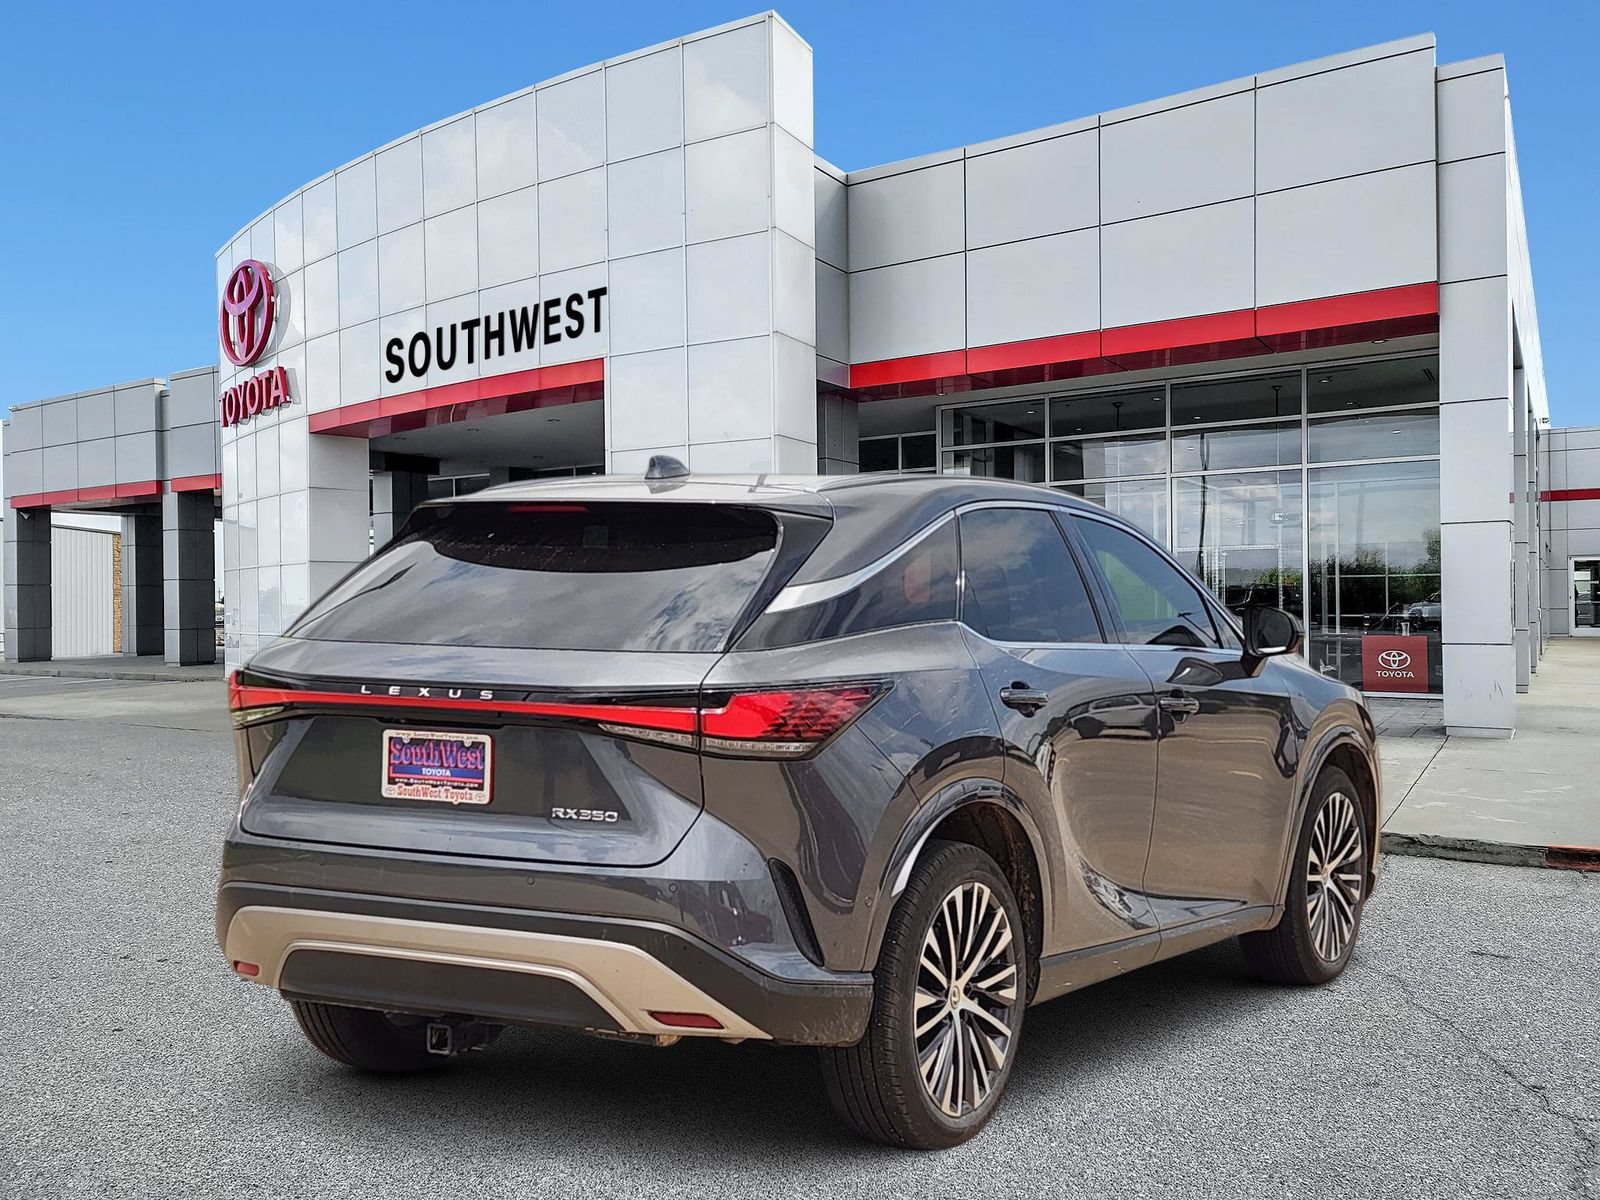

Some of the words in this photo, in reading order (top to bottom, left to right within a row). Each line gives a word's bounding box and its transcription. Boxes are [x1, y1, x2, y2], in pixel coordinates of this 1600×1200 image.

[385, 286, 608, 384] SOUTHWEST
[219, 366, 291, 427] TOYOTA
[1376, 670, 1415, 678] TOYOTA
[360, 684, 494, 700] LEXUS
[422, 767, 452, 777] TOYOTA
[444, 788, 473, 803] Toyota
[552, 807, 618, 822] RX350
